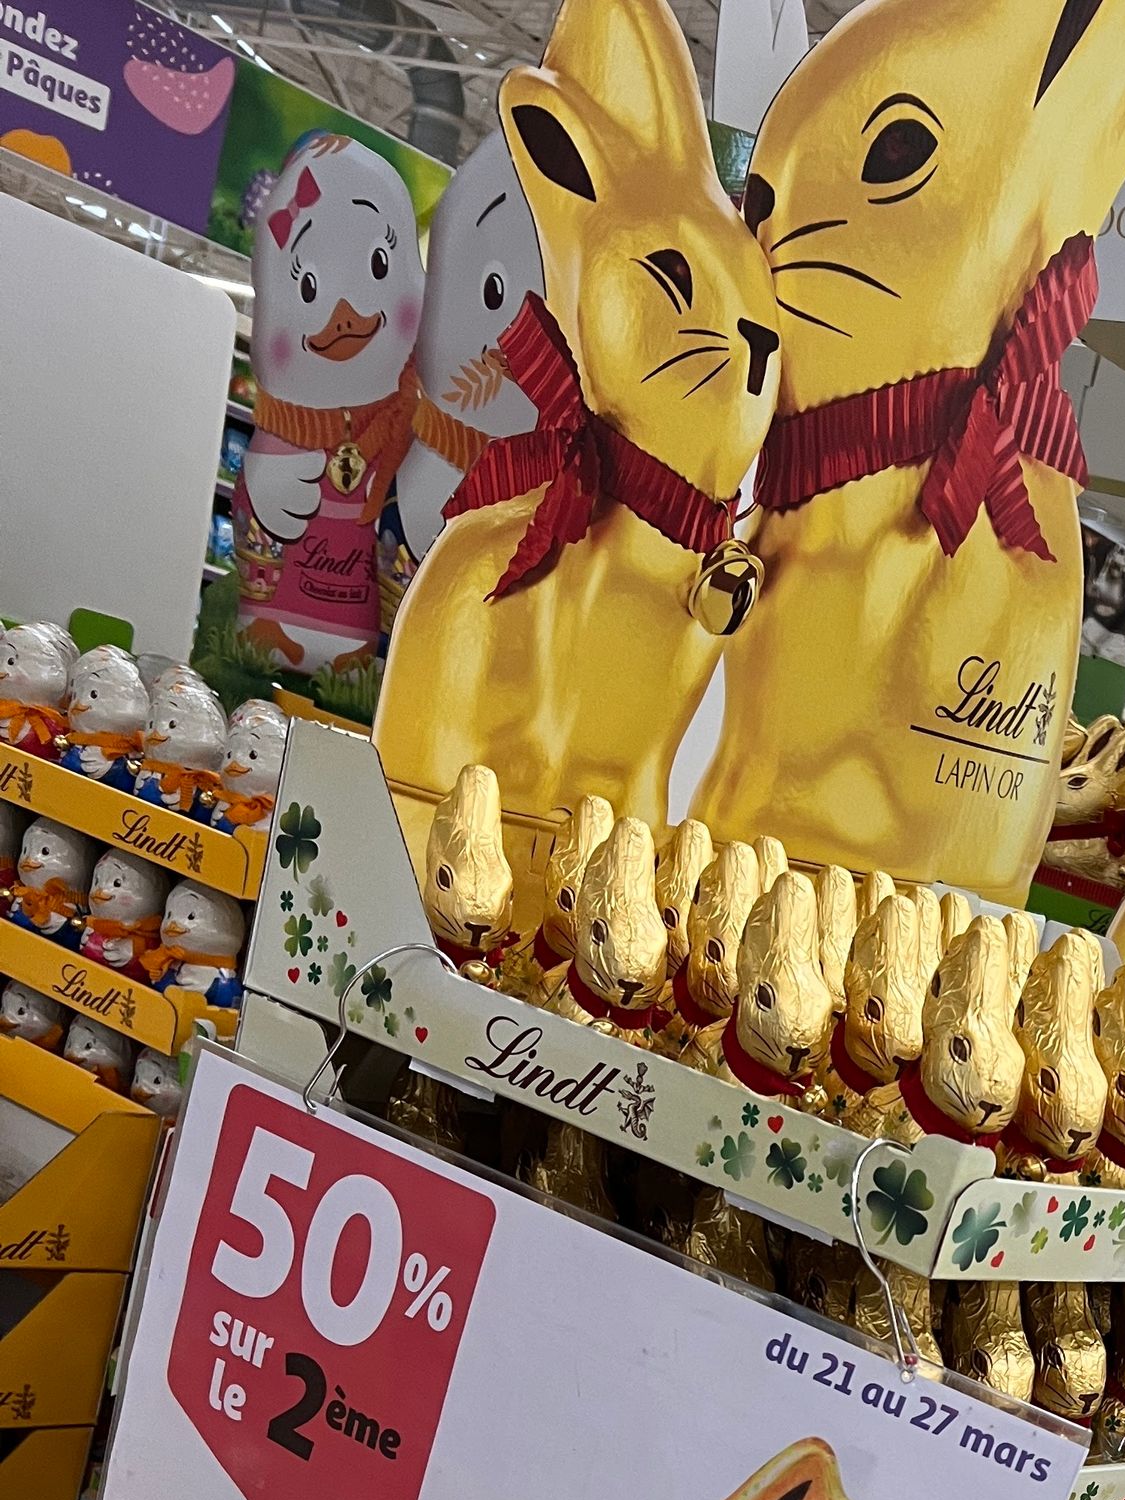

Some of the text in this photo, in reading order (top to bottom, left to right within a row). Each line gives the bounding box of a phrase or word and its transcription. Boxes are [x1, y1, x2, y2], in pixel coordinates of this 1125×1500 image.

[6, 50, 101, 114] Pâques
[294, 535, 363, 577] Lindt
[935, 656, 1036, 739] Lindt
[935, 753, 1024, 801] LAPIN OR
[112, 809, 187, 862] Lindt
[53, 964, 121, 1016] Lindt
[465, 1016, 621, 1116] Lindt
[211, 1126, 452, 1345] 50%
[209, 1310, 274, 1368] sur
[208, 1352, 401, 1462] le 2ème
[765, 1333, 1052, 1482] du 21 au 27 mars
